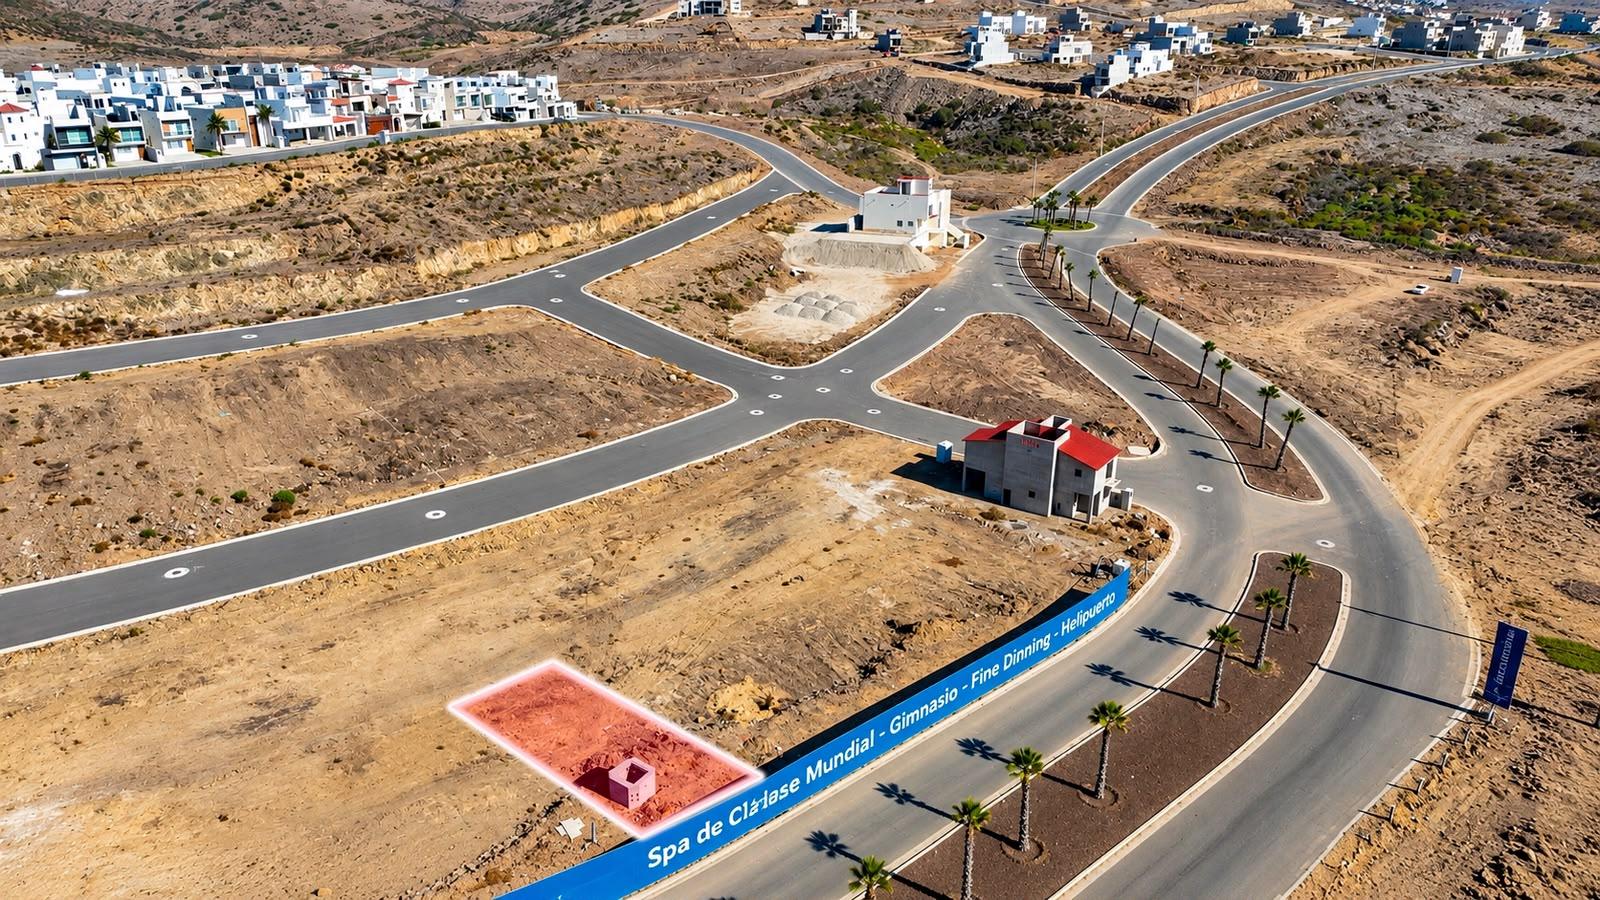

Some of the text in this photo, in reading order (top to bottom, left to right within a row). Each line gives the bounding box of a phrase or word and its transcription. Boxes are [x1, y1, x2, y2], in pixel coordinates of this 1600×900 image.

[648, 837, 690, 868] Spa
[697, 821, 723, 844] de
[806, 729, 875, 785] Mundial
[889, 687, 958, 735] Gimnasio
[971, 663, 1000, 689] Fine
[1003, 633, 1050, 671] Dinning
[1061, 591, 1116, 637] Helipuerto
